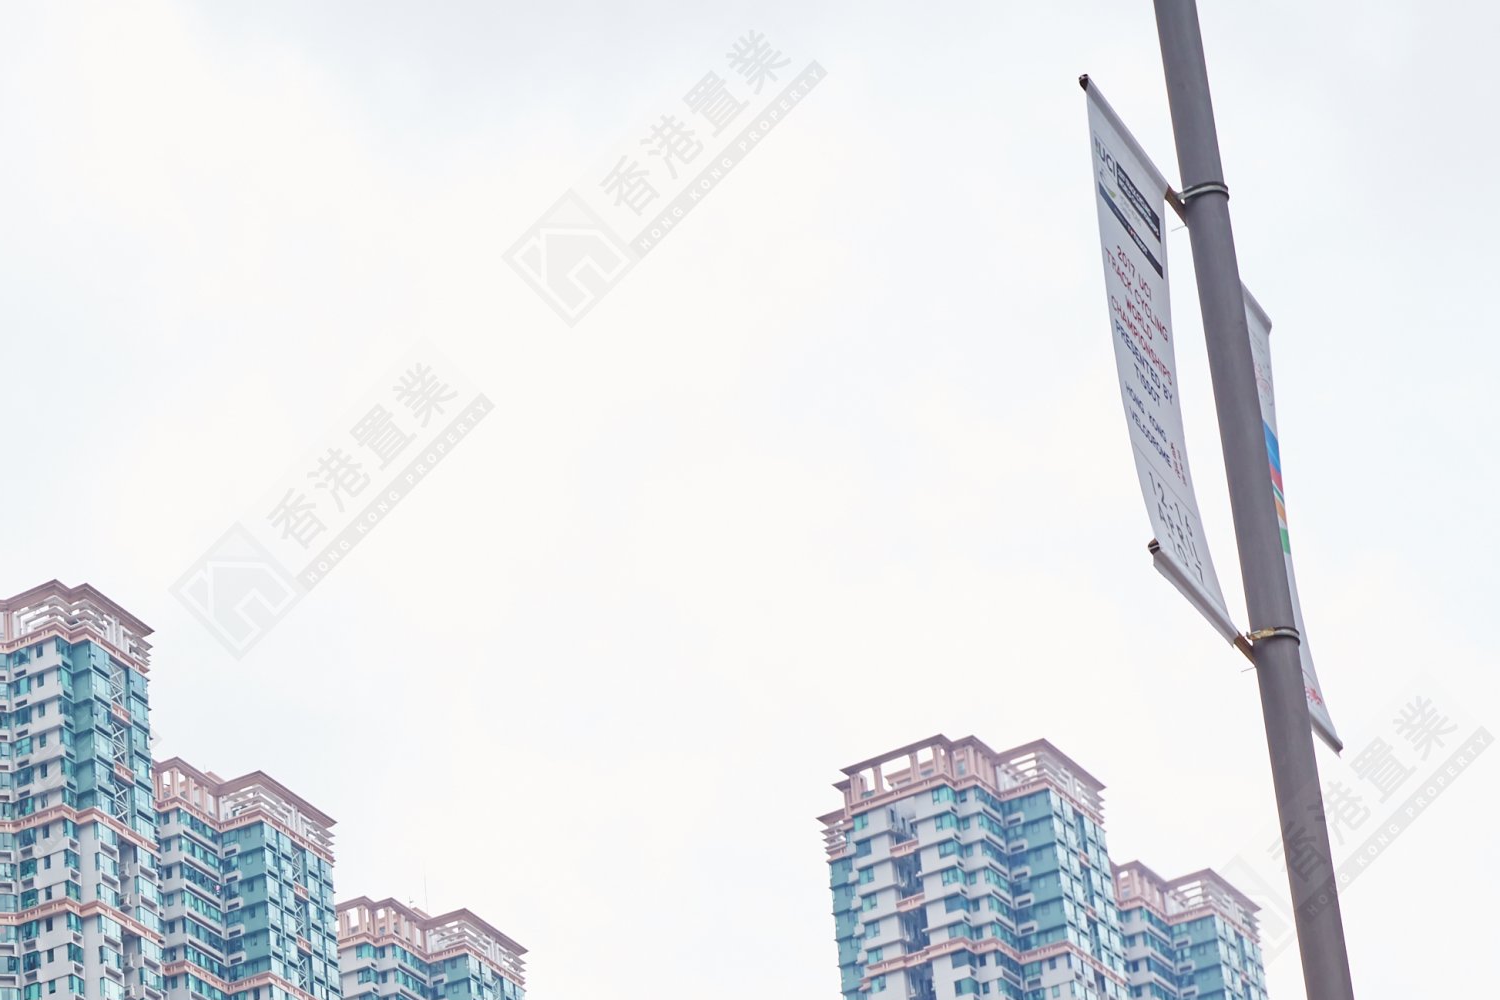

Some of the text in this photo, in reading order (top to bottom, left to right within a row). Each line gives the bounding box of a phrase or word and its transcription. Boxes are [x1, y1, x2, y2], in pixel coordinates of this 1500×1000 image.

[1105, 247, 1133, 295] TRACK
[1134, 289, 1169, 343] CYCLING
[1116, 244, 1136, 277] 2017
[1138, 273, 1152, 301] UCI
[1110, 295, 1173, 386] CHAMPIONSHIPS
[1125, 294, 1153, 341] WORLD
[1114, 318, 1173, 406] PRESENTED BY
[1133, 362, 1160, 407] TISSOT
[1124, 380, 1168, 443] HONG KONG
